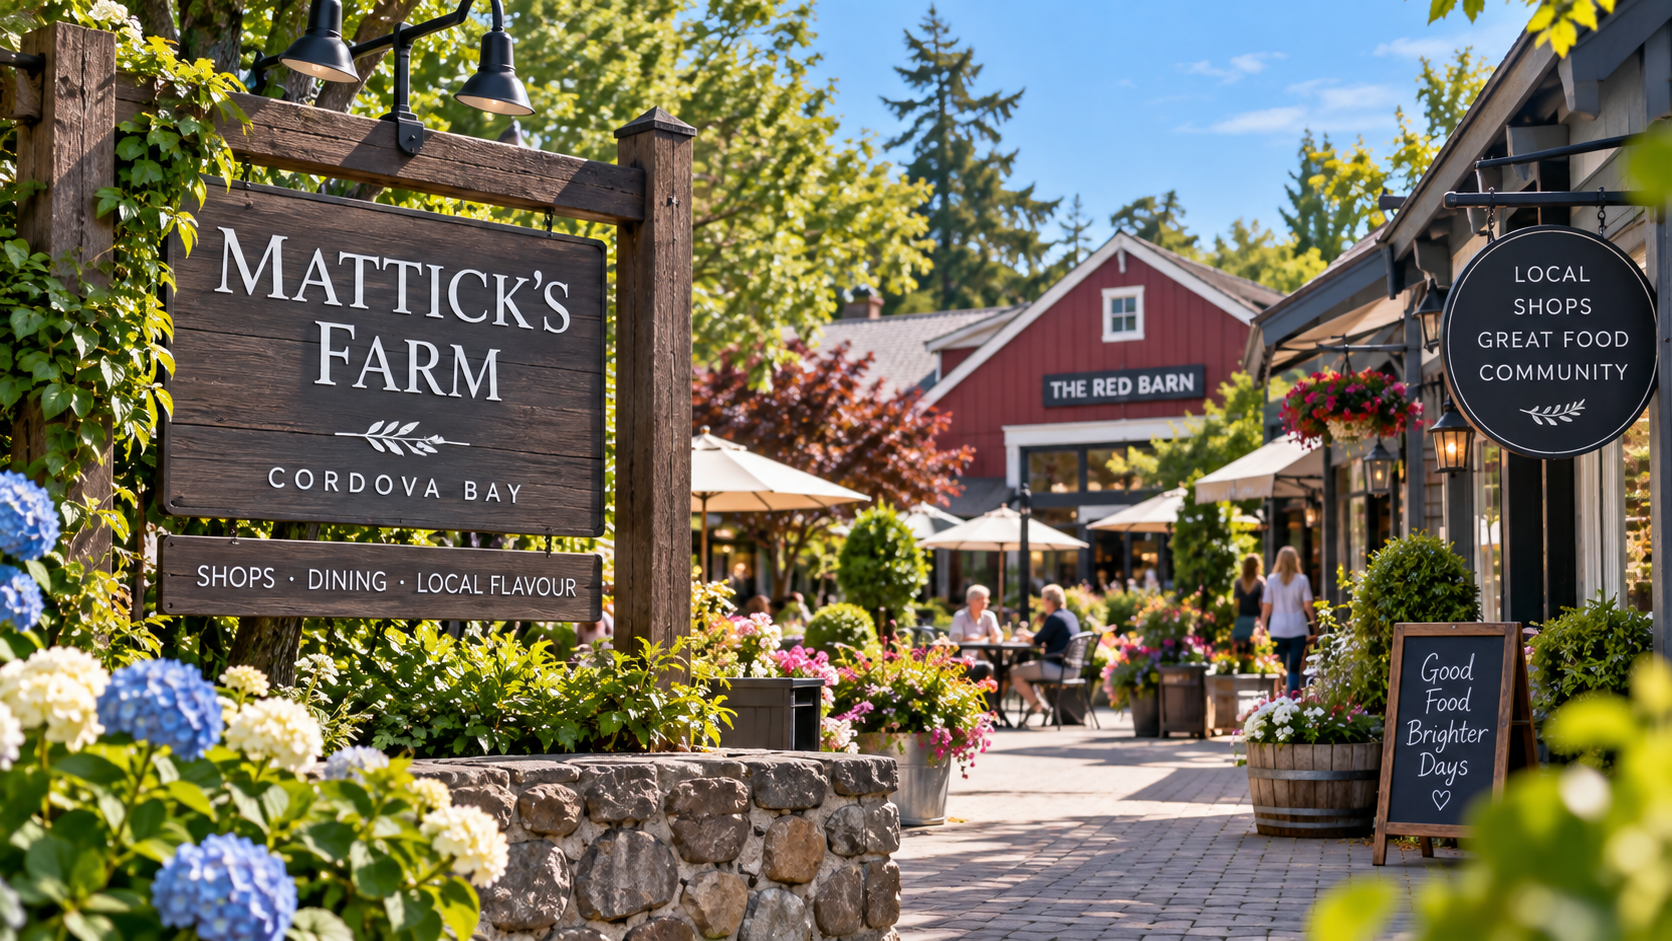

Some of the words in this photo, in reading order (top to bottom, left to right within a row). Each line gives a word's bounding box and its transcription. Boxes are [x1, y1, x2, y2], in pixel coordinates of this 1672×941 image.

[1516, 266, 1590, 282] LOCAL
[1515, 298, 1591, 315] SHOPS
[1478, 332, 1553, 348] GREAT
[1564, 331, 1628, 347] FOOD
[315, 320, 502, 401] FARM
[1480, 364, 1627, 381] COMMUNITY
[1051, 380, 1086, 398] THE
[1093, 377, 1132, 396] RED
[1139, 373, 1193, 394] BARN
[269, 467, 440, 498] CORDOVA
[465, 481, 521, 503] BAY
[197, 565, 275, 588] SHOPS
[309, 569, 386, 591] DINING
[418, 573, 483, 594] LOCAL
[491, 575, 576, 597] FLAVOUR
[1422, 653, 1474, 684] Good
[1426, 687, 1471, 714] Food
[1407, 720, 1488, 753] Brighter
[1418, 752, 1467, 786] Days
